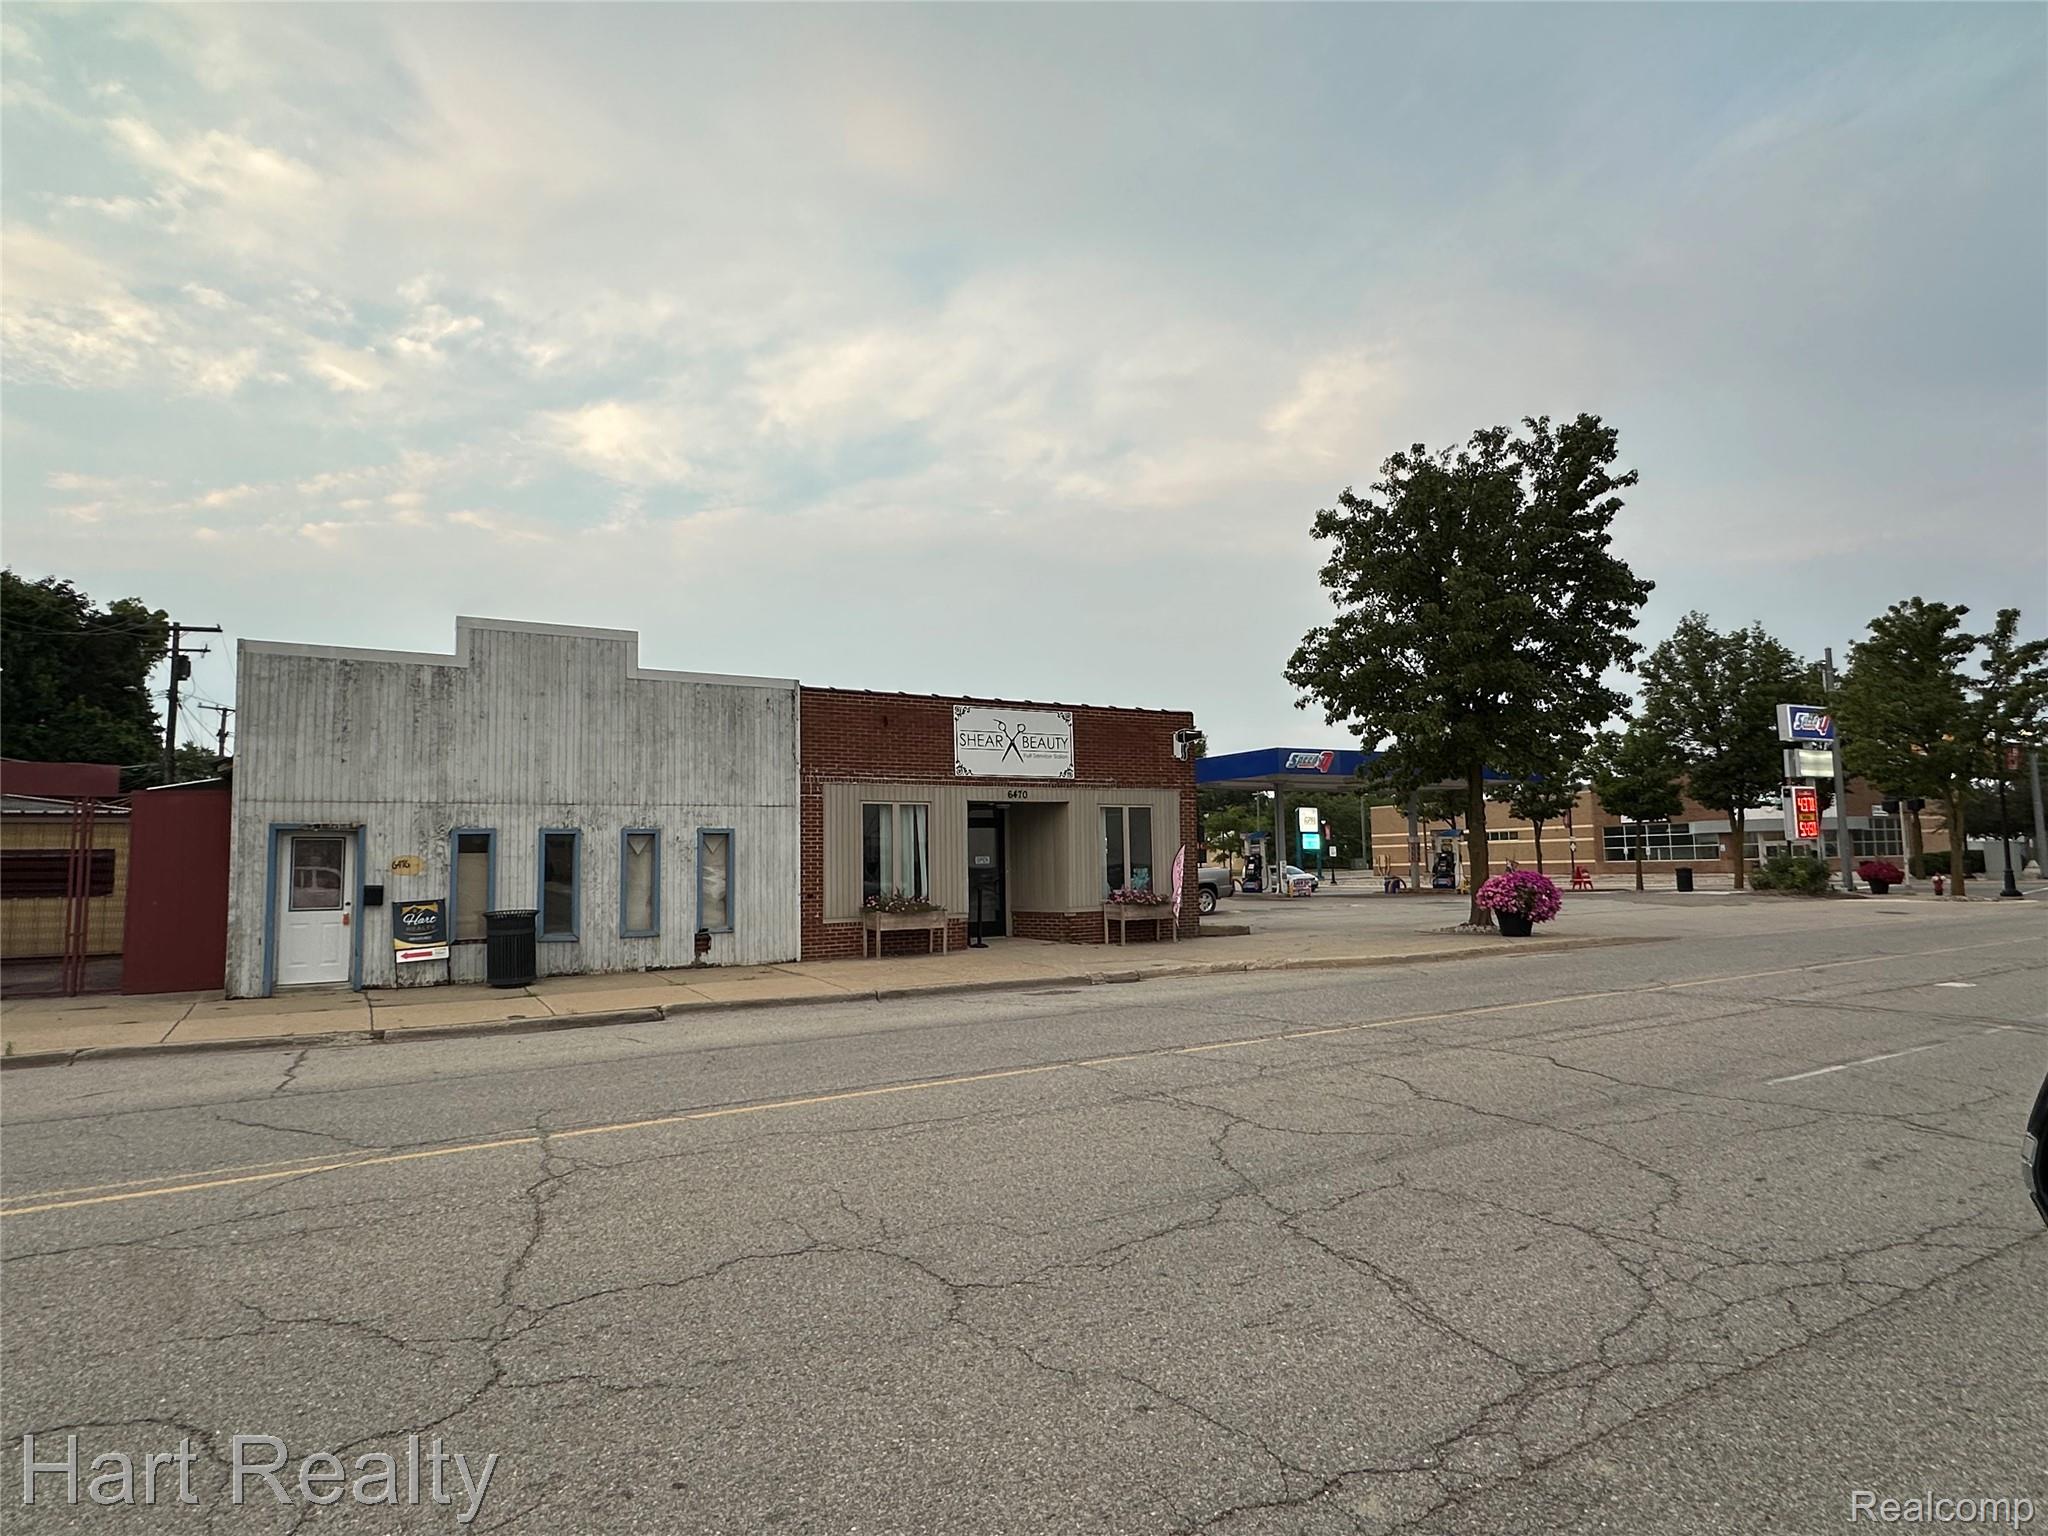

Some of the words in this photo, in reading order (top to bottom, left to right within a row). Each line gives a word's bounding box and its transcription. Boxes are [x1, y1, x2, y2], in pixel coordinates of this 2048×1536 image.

[960, 732, 1003, 749] SHEAR
[1022, 736, 1069, 750] BEAUTY
[1007, 790, 1028, 799] 6470
[402, 909, 437, 926] Hart
